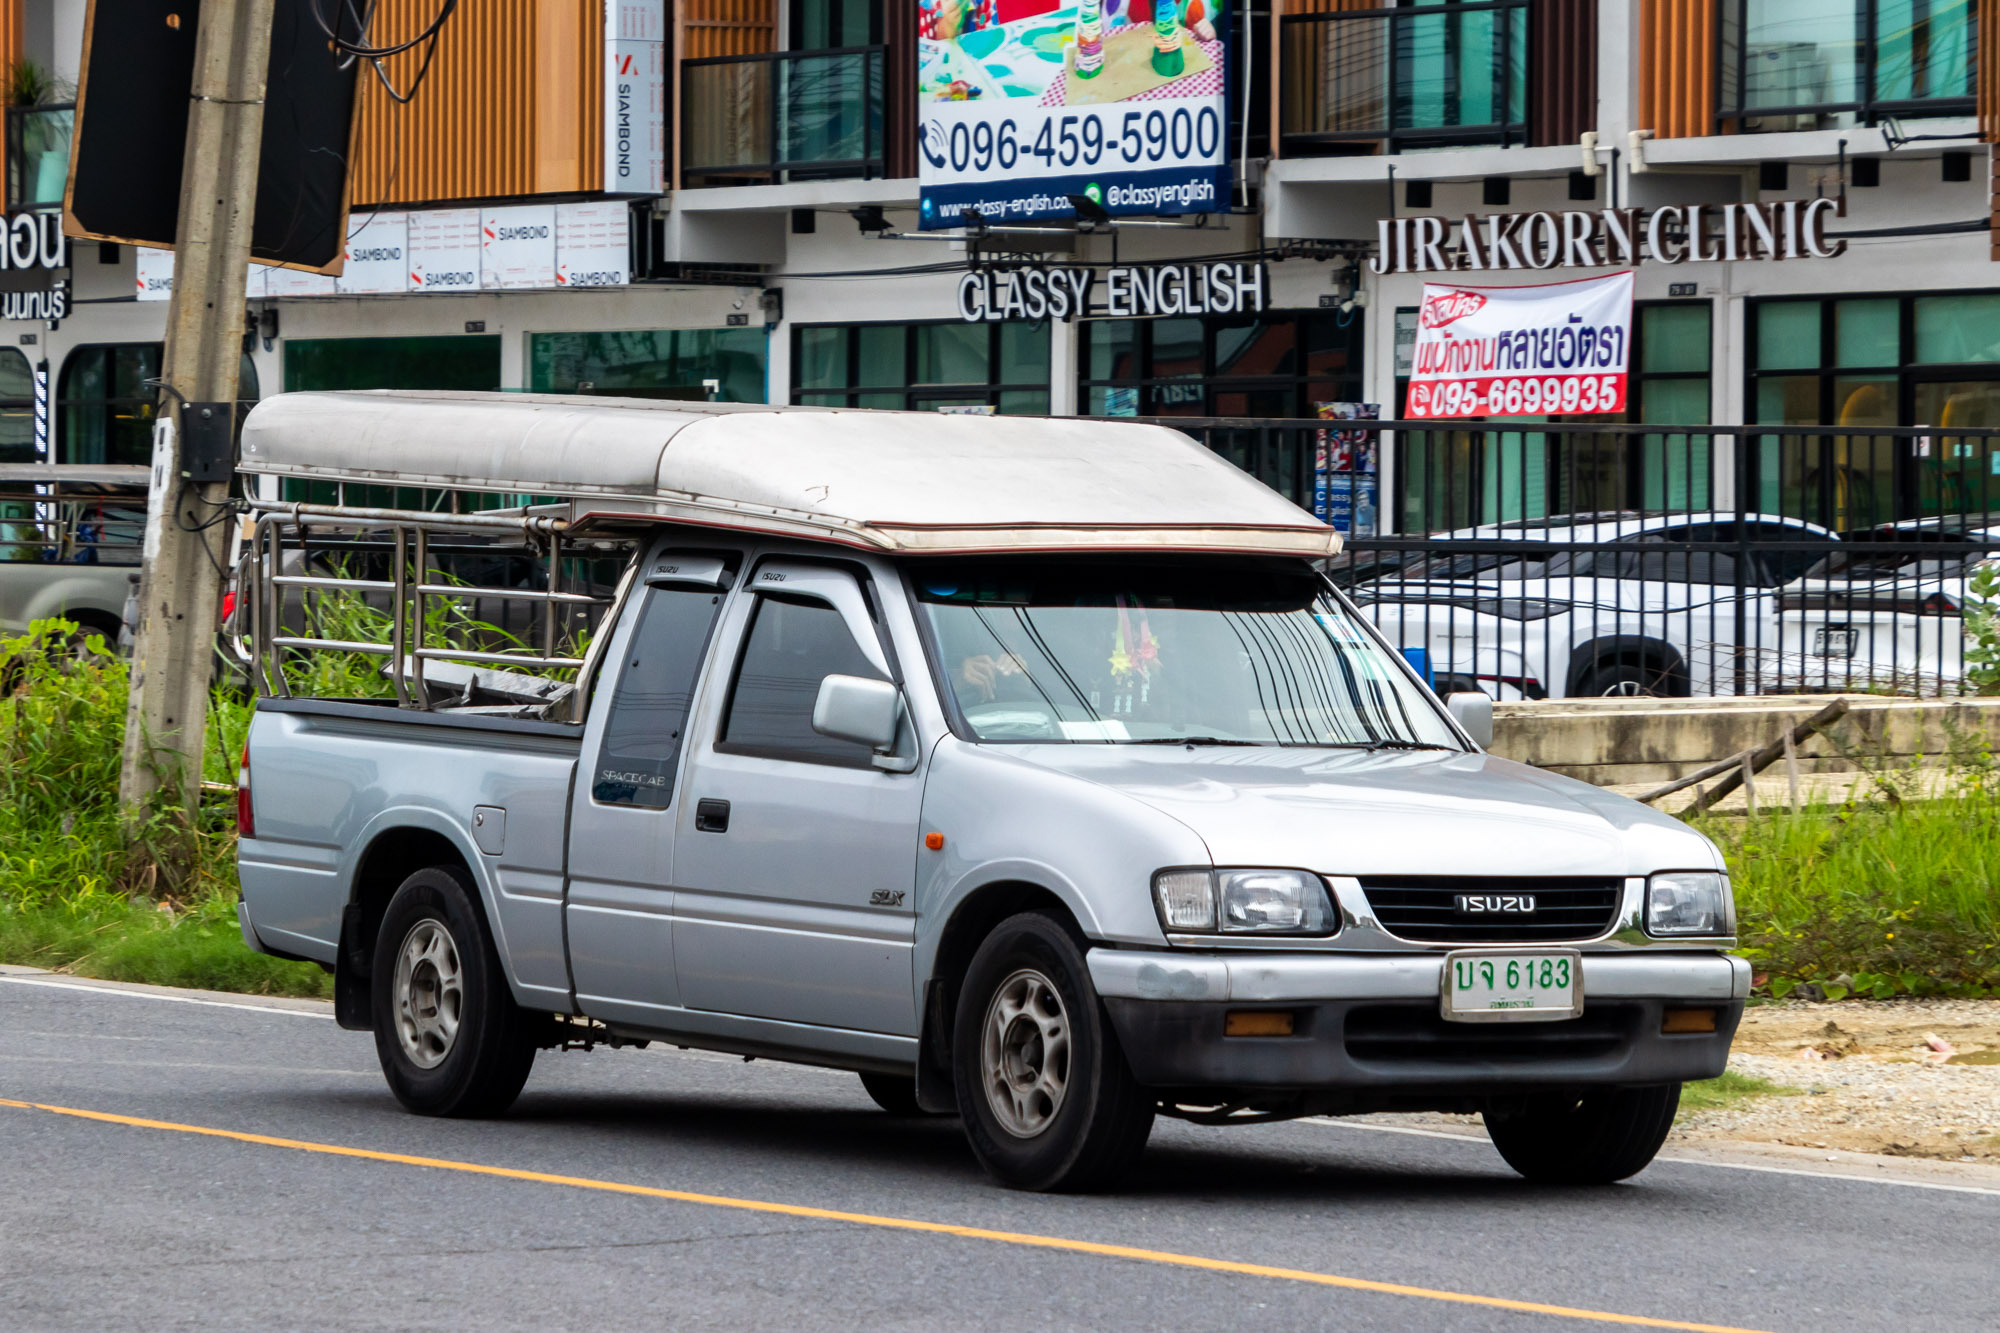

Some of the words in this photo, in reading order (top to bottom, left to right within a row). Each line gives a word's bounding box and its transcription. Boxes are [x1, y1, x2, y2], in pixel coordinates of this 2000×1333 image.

[618, 83, 631, 178] SIAMBOND
[950, 105, 1219, 172] 096-459-5900
[1107, 179, 1215, 208] @classyenglish
[498, 225, 550, 241] SIAMBOND
[1369, 206, 1641, 275] JIRAKORN
[1646, 198, 1845, 265] CLINIC
[352, 247, 402, 262] SIAMBOND
[425, 271, 475, 286] SIAMBOND
[569, 271, 622, 286] SIAMBOND
[958, 268, 1090, 322] CLASSY
[1107, 262, 1262, 316] ENGLISH
[1431, 375, 1618, 417] 095-6699935
[655, 565, 680, 574] ISUZU
[761, 572, 787, 582] ISUZU
[1462, 896, 1536, 912] ISUZU
[1455, 960, 1494, 990] บจ
[1506, 958, 1570, 990] 6183
